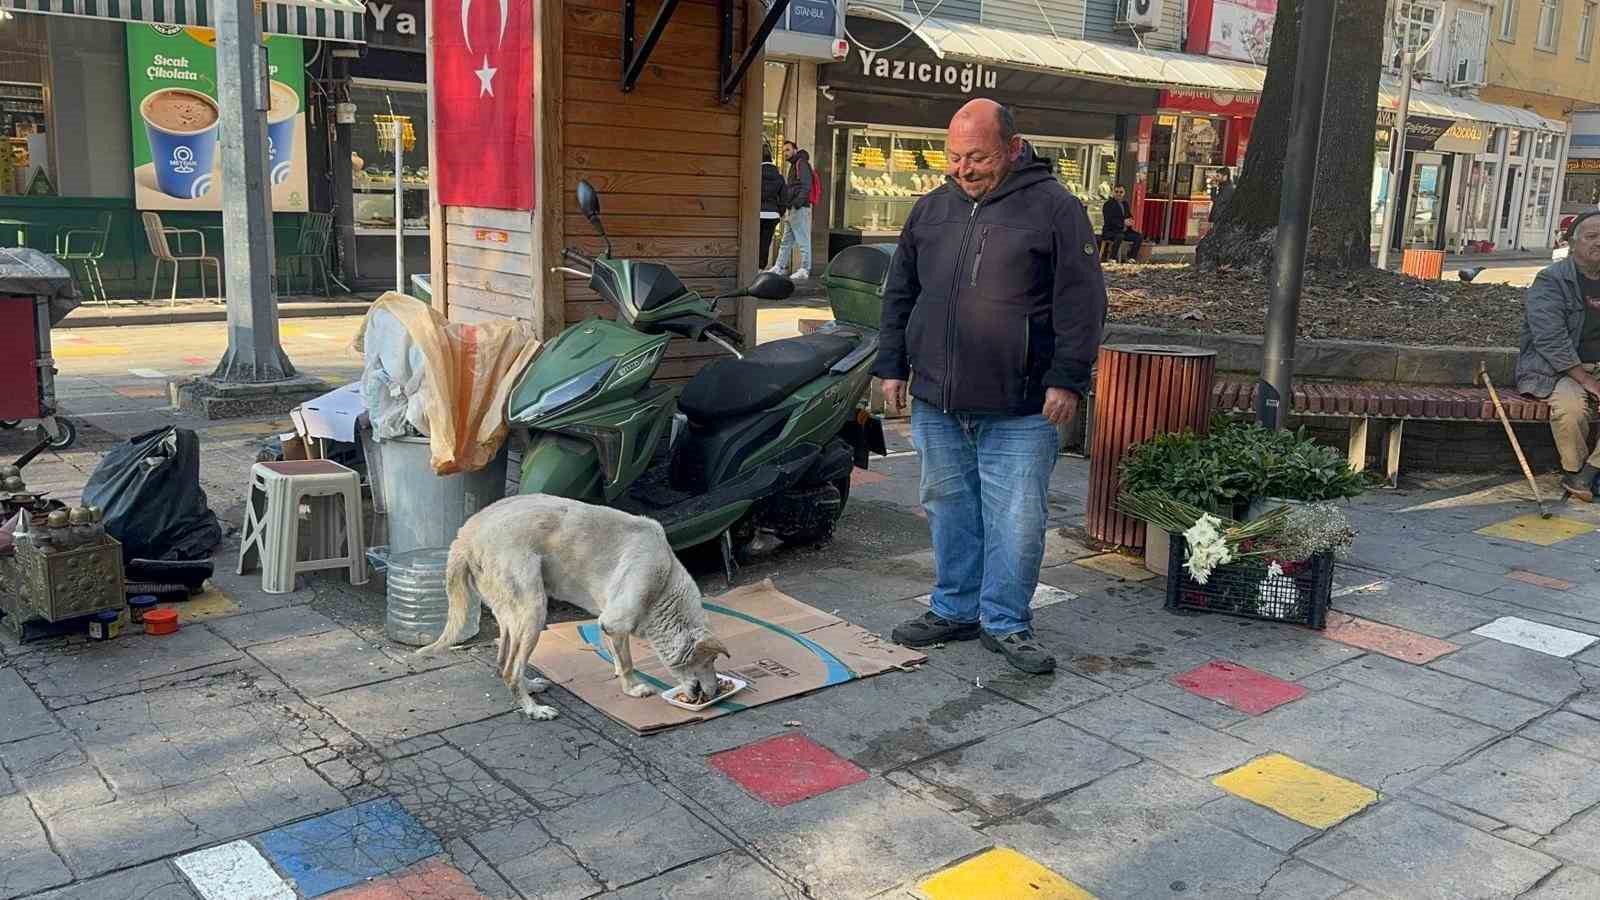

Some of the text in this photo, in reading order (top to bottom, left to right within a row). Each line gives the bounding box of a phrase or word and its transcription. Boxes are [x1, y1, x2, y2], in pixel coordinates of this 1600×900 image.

[153, 54, 190, 68] Sıcak
[146, 65, 198, 81] Çikolata
[858, 49, 998, 94] Yazıcıoğlu
